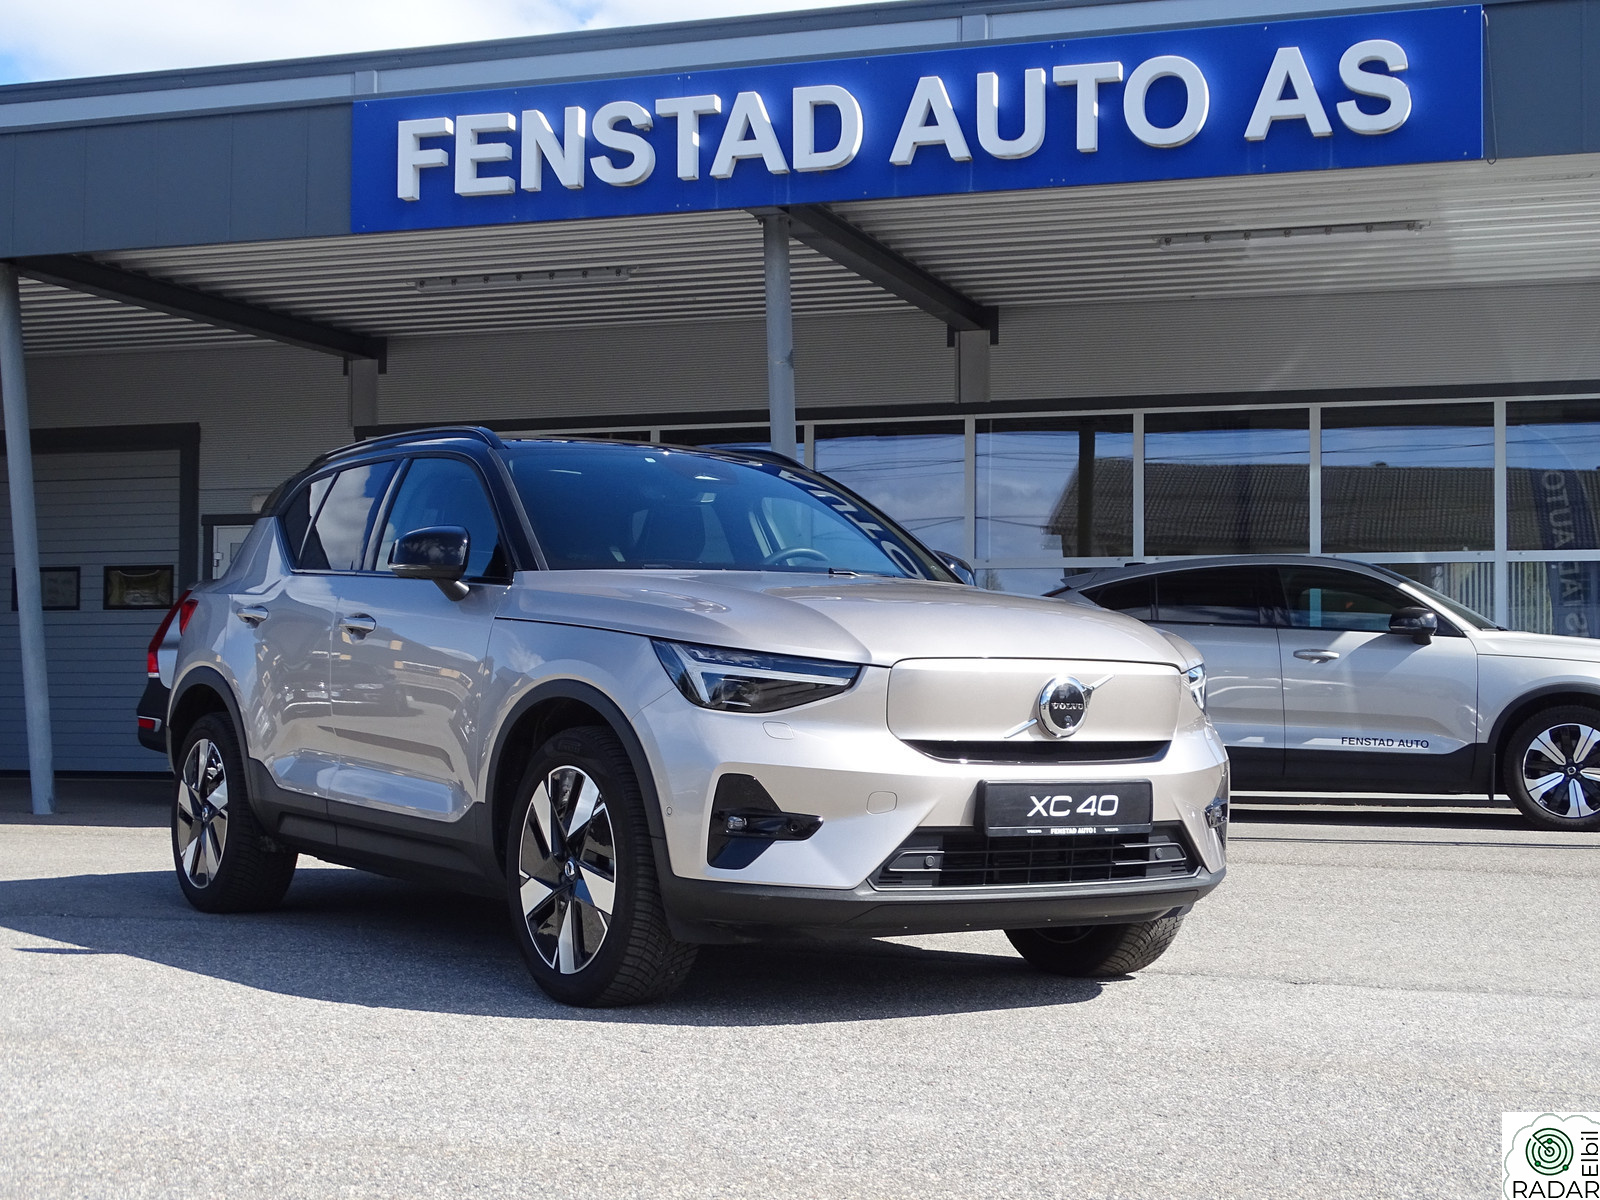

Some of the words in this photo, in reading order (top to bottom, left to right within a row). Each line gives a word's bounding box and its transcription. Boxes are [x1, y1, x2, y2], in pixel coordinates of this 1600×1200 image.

[397, 84, 863, 201] FENSTAD
[889, 55, 1210, 165] AUTO
[1244, 39, 1412, 141] AS
[1050, 702, 1084, 710] VOLVO
[1341, 736, 1394, 747] FENSTAD
[1397, 738, 1430, 749] AUTO
[1027, 795, 1072, 817] XC
[1076, 795, 1119, 817] 40
